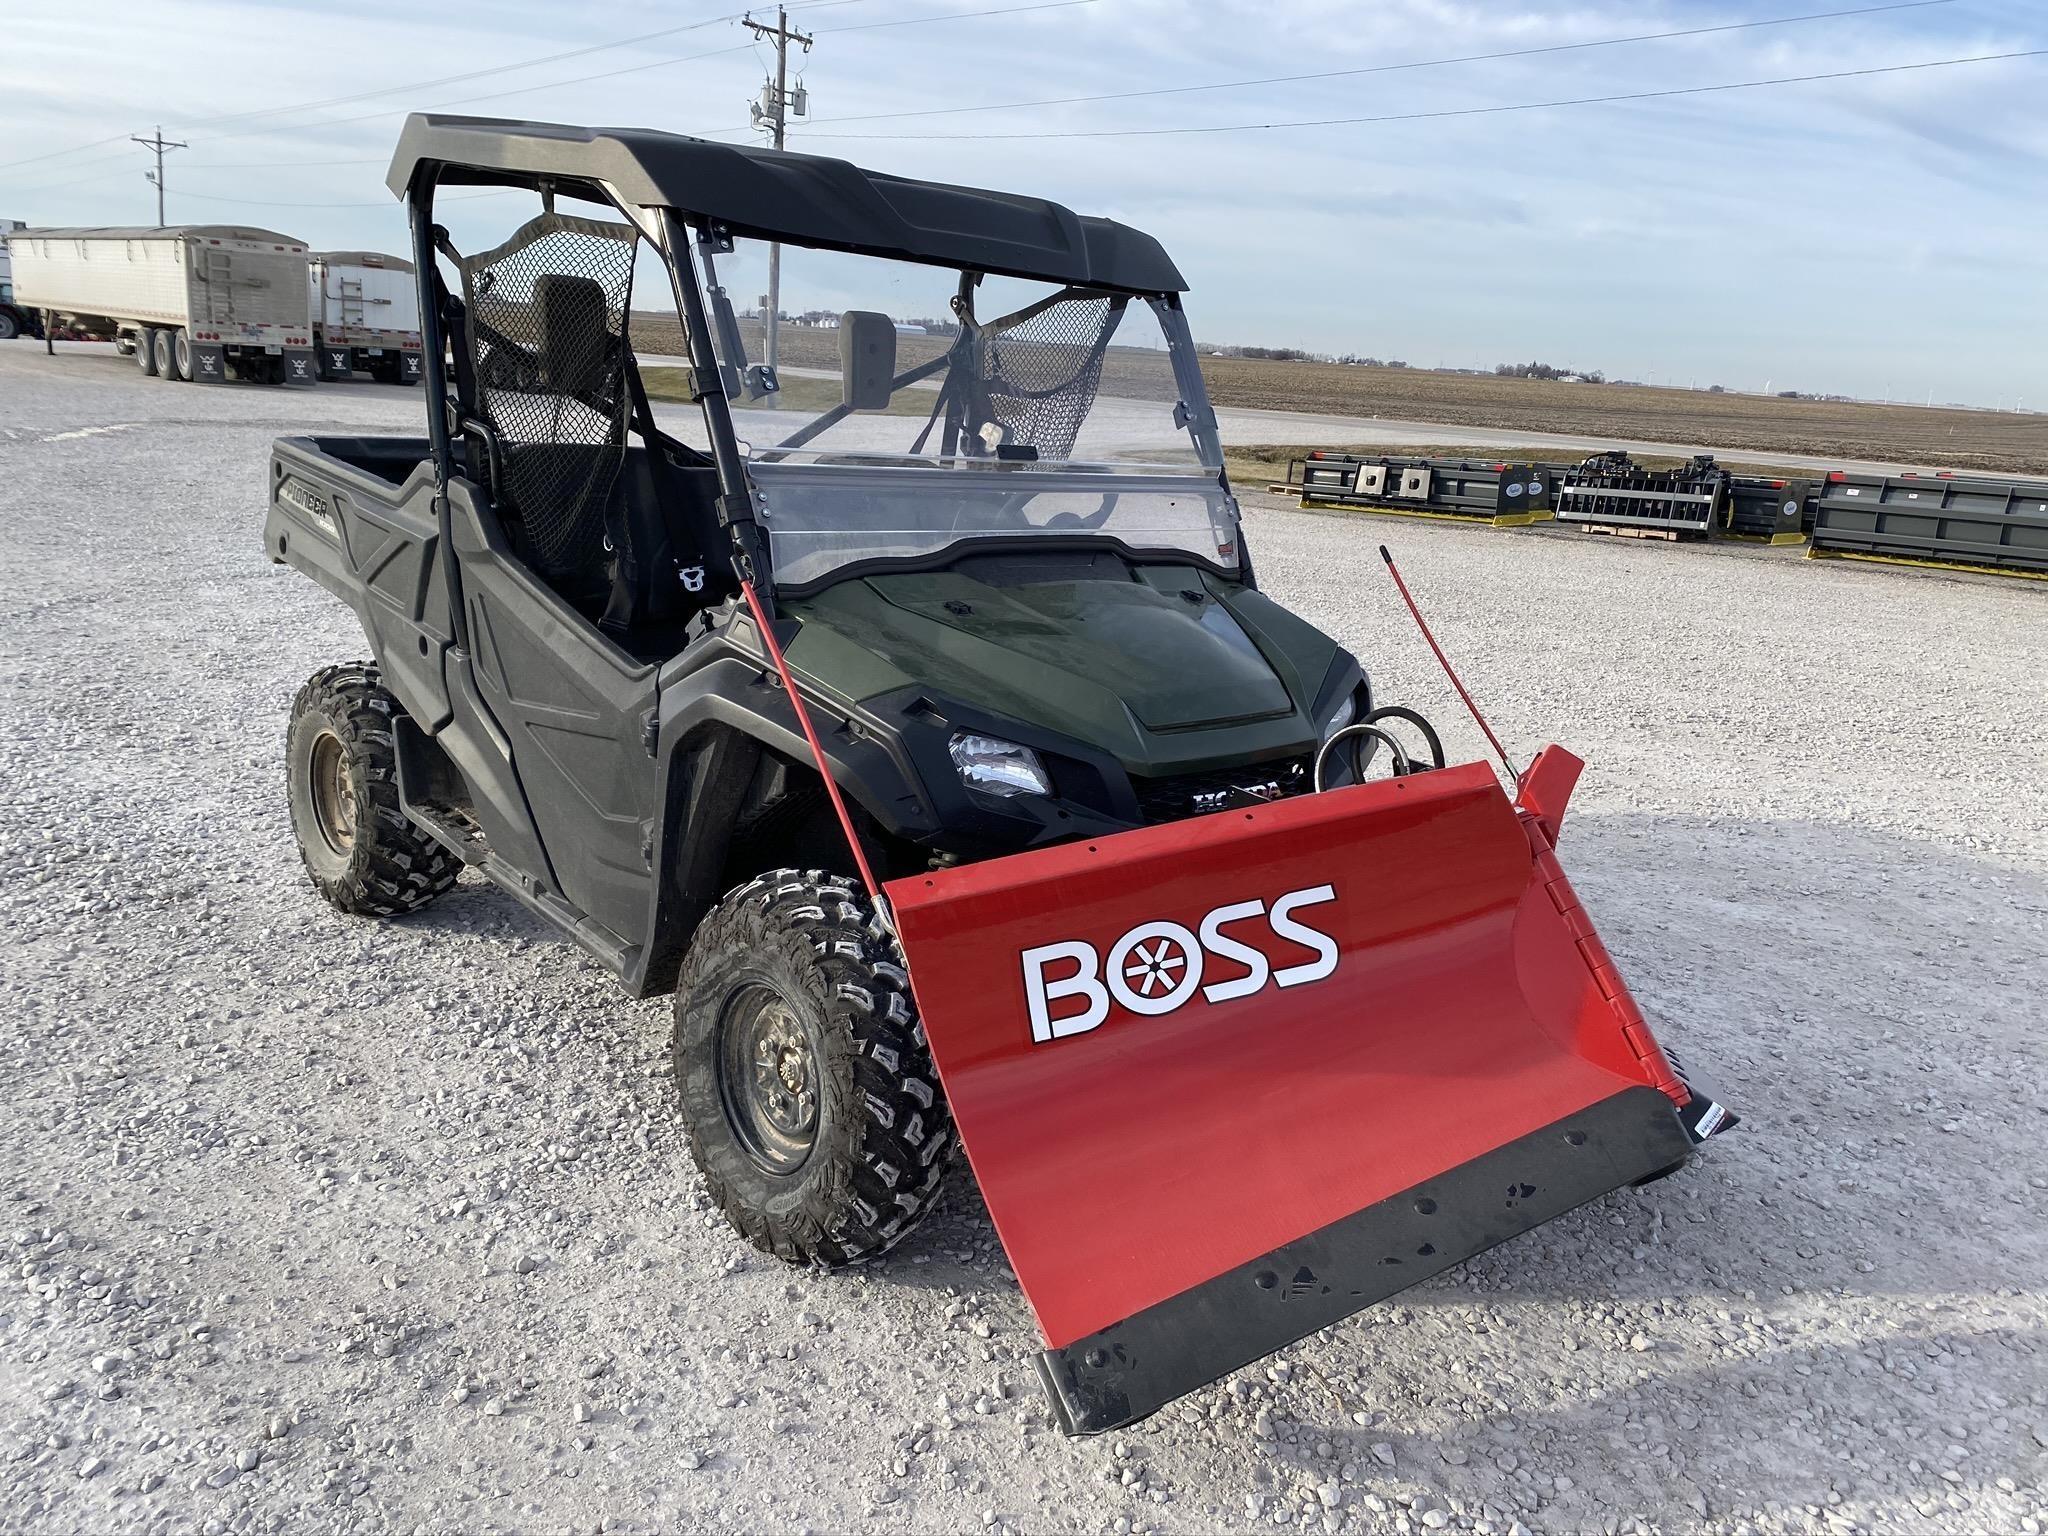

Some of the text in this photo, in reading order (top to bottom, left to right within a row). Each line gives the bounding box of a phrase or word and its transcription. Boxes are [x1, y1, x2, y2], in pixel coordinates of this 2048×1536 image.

[287, 480, 328, 519] PIONEER
[1193, 781, 1283, 814] HODA
[1021, 883, 1339, 1043] BOSS
